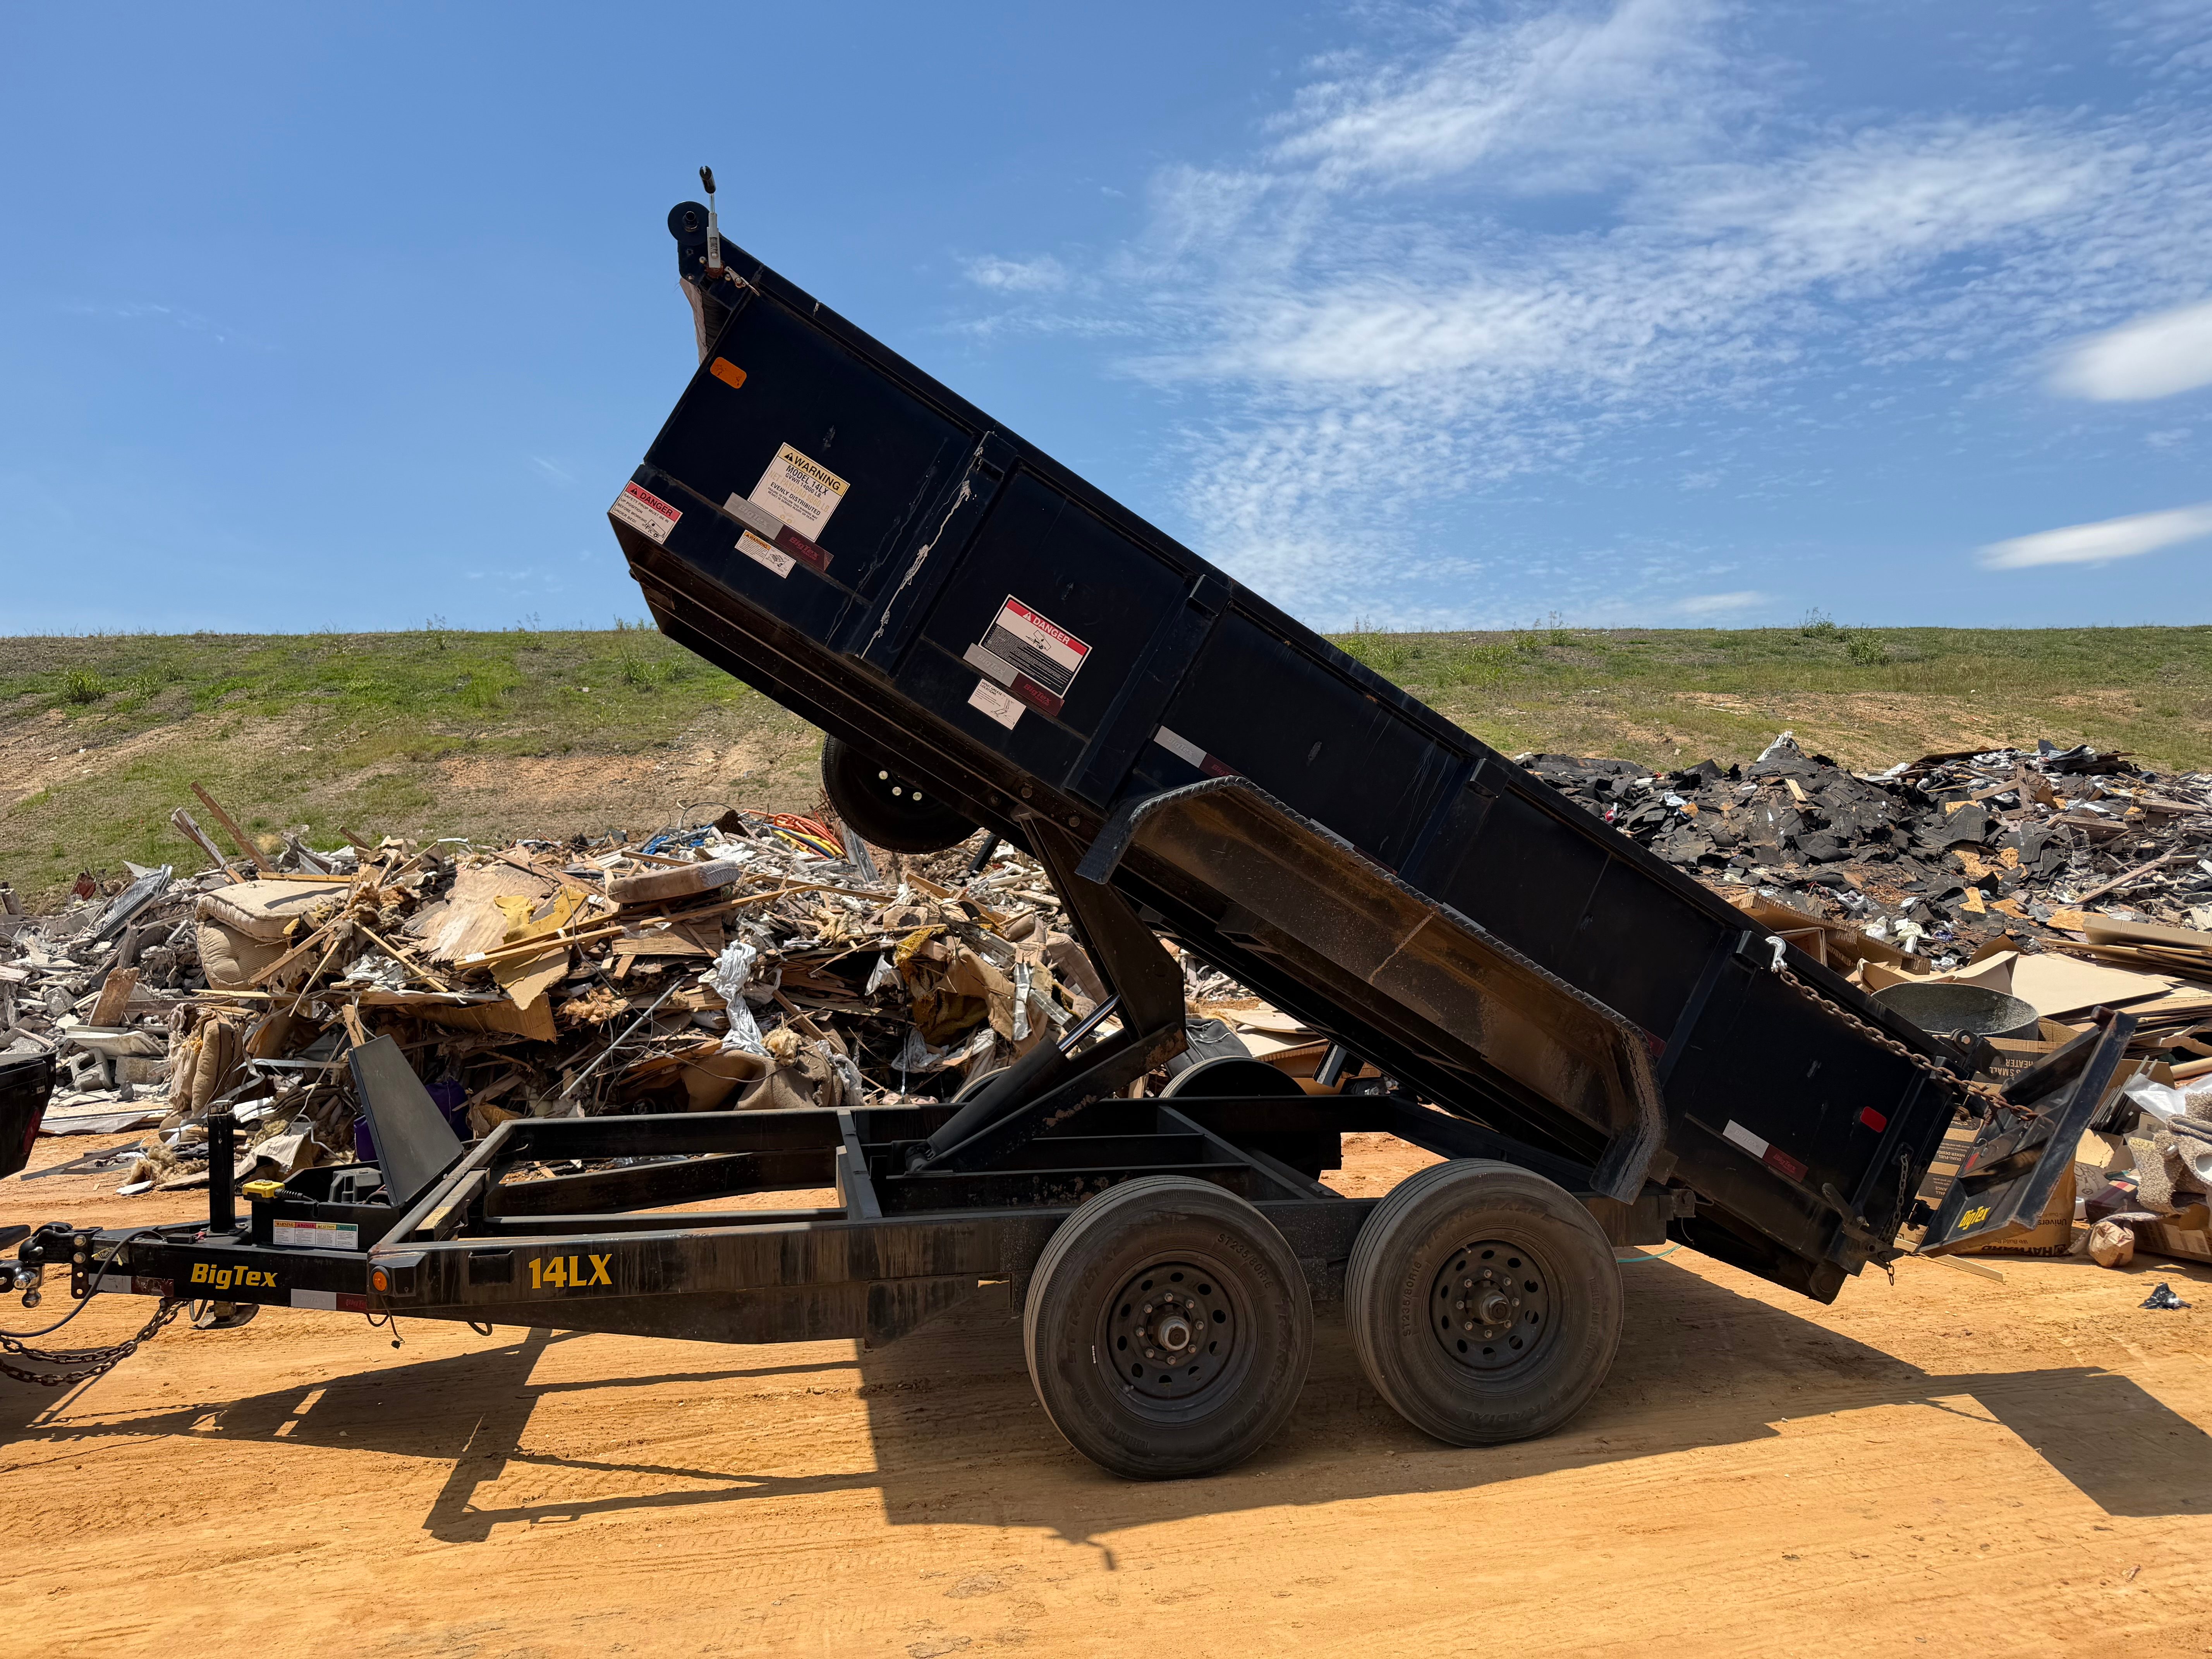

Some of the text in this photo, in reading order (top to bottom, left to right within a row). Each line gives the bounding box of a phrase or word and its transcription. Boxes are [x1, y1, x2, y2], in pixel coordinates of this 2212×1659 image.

[768, 470, 782, 483] NET
[780, 477, 807, 498] PAYLOAD
[785, 464, 829, 496] MODEL 14LX
[785, 472, 800, 484] GVWR
[800, 482, 815, 494] 14000
[792, 455, 842, 491] WARNING
[623, 493, 638, 504] SAFETY
[637, 501, 649, 510] PROP
[648, 508, 659, 517] MUST
[625, 501, 643, 514] POSITION
[639, 491, 673, 517] DANGER
[770, 482, 821, 516] EVENLY DISTRIBUTED
[613, 507, 627, 517] UNDER
[617, 503, 647, 523] BEFORE WORKING
[737, 503, 770, 528] BigTex
[749, 535, 768, 548] WARNING
[788, 536, 820, 559] BigTex
[1032, 616, 1071, 645] DANGER
[976, 653, 1005, 675] BigTex
[980, 684, 996, 696] LOCATIONS
[1023, 683, 1052, 705] BigTex
[1989, 1066, 2014, 1076] SMALL
[2005, 1059, 2033, 1068] HEATER
[1772, 1153, 1797, 1173] BigTex
[1958, 1206, 1990, 1231] BigTex
[529, 1254, 612, 1289] 14LX
[1217, 1233, 1274, 1289] ST235/80R16
[191, 1263, 278, 1290] BigTex
[1403, 1261, 1422, 1337] ST235/80R16
